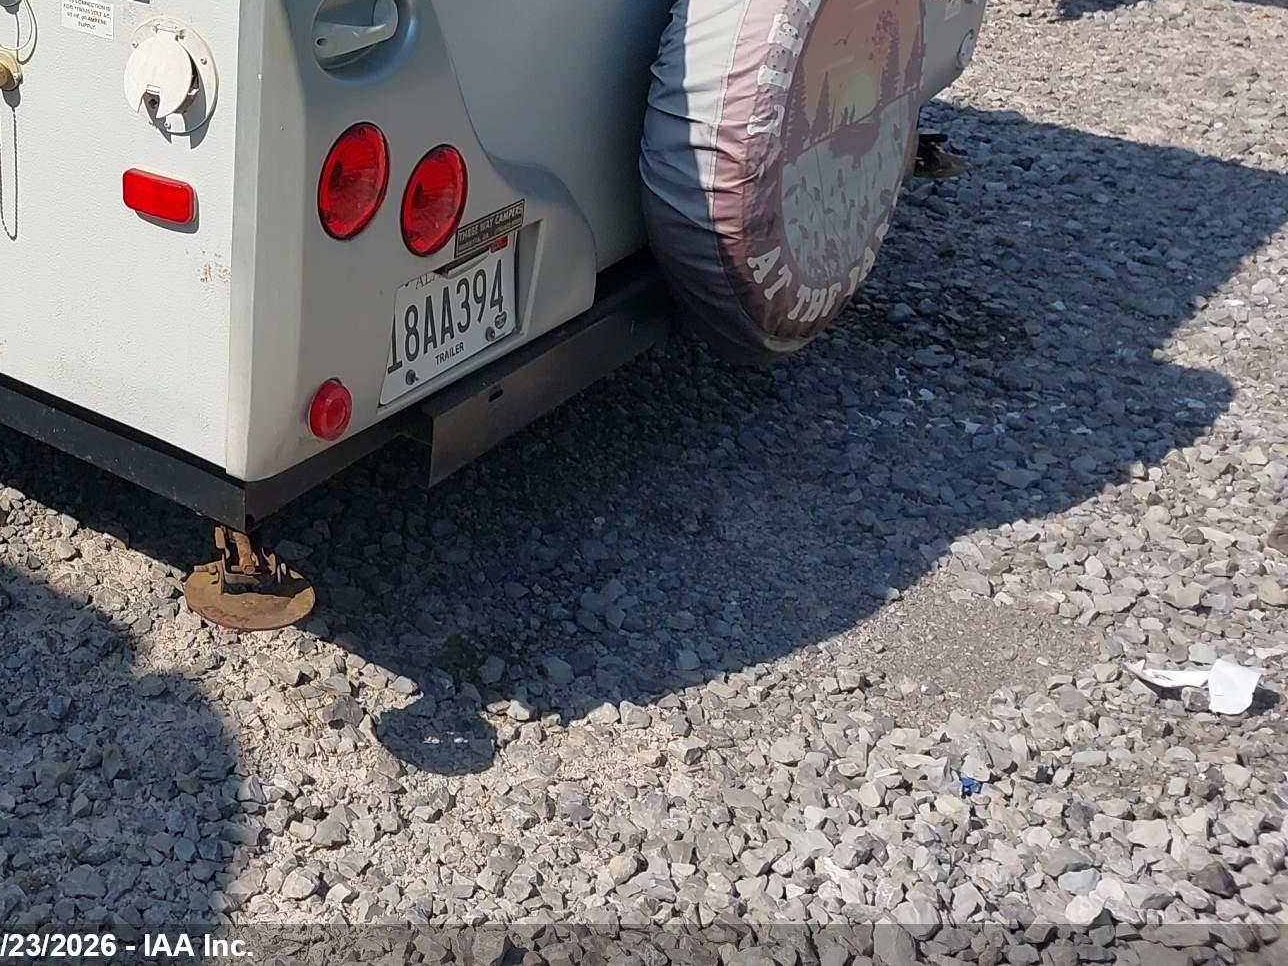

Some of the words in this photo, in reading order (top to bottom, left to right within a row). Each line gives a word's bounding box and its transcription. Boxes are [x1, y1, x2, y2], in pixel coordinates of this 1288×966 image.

[387, 259, 504, 374] 18AA394
[747, 246, 793, 300] AT
[787, 281, 843, 323] THE
[435, 342, 464, 366] TRAILER
